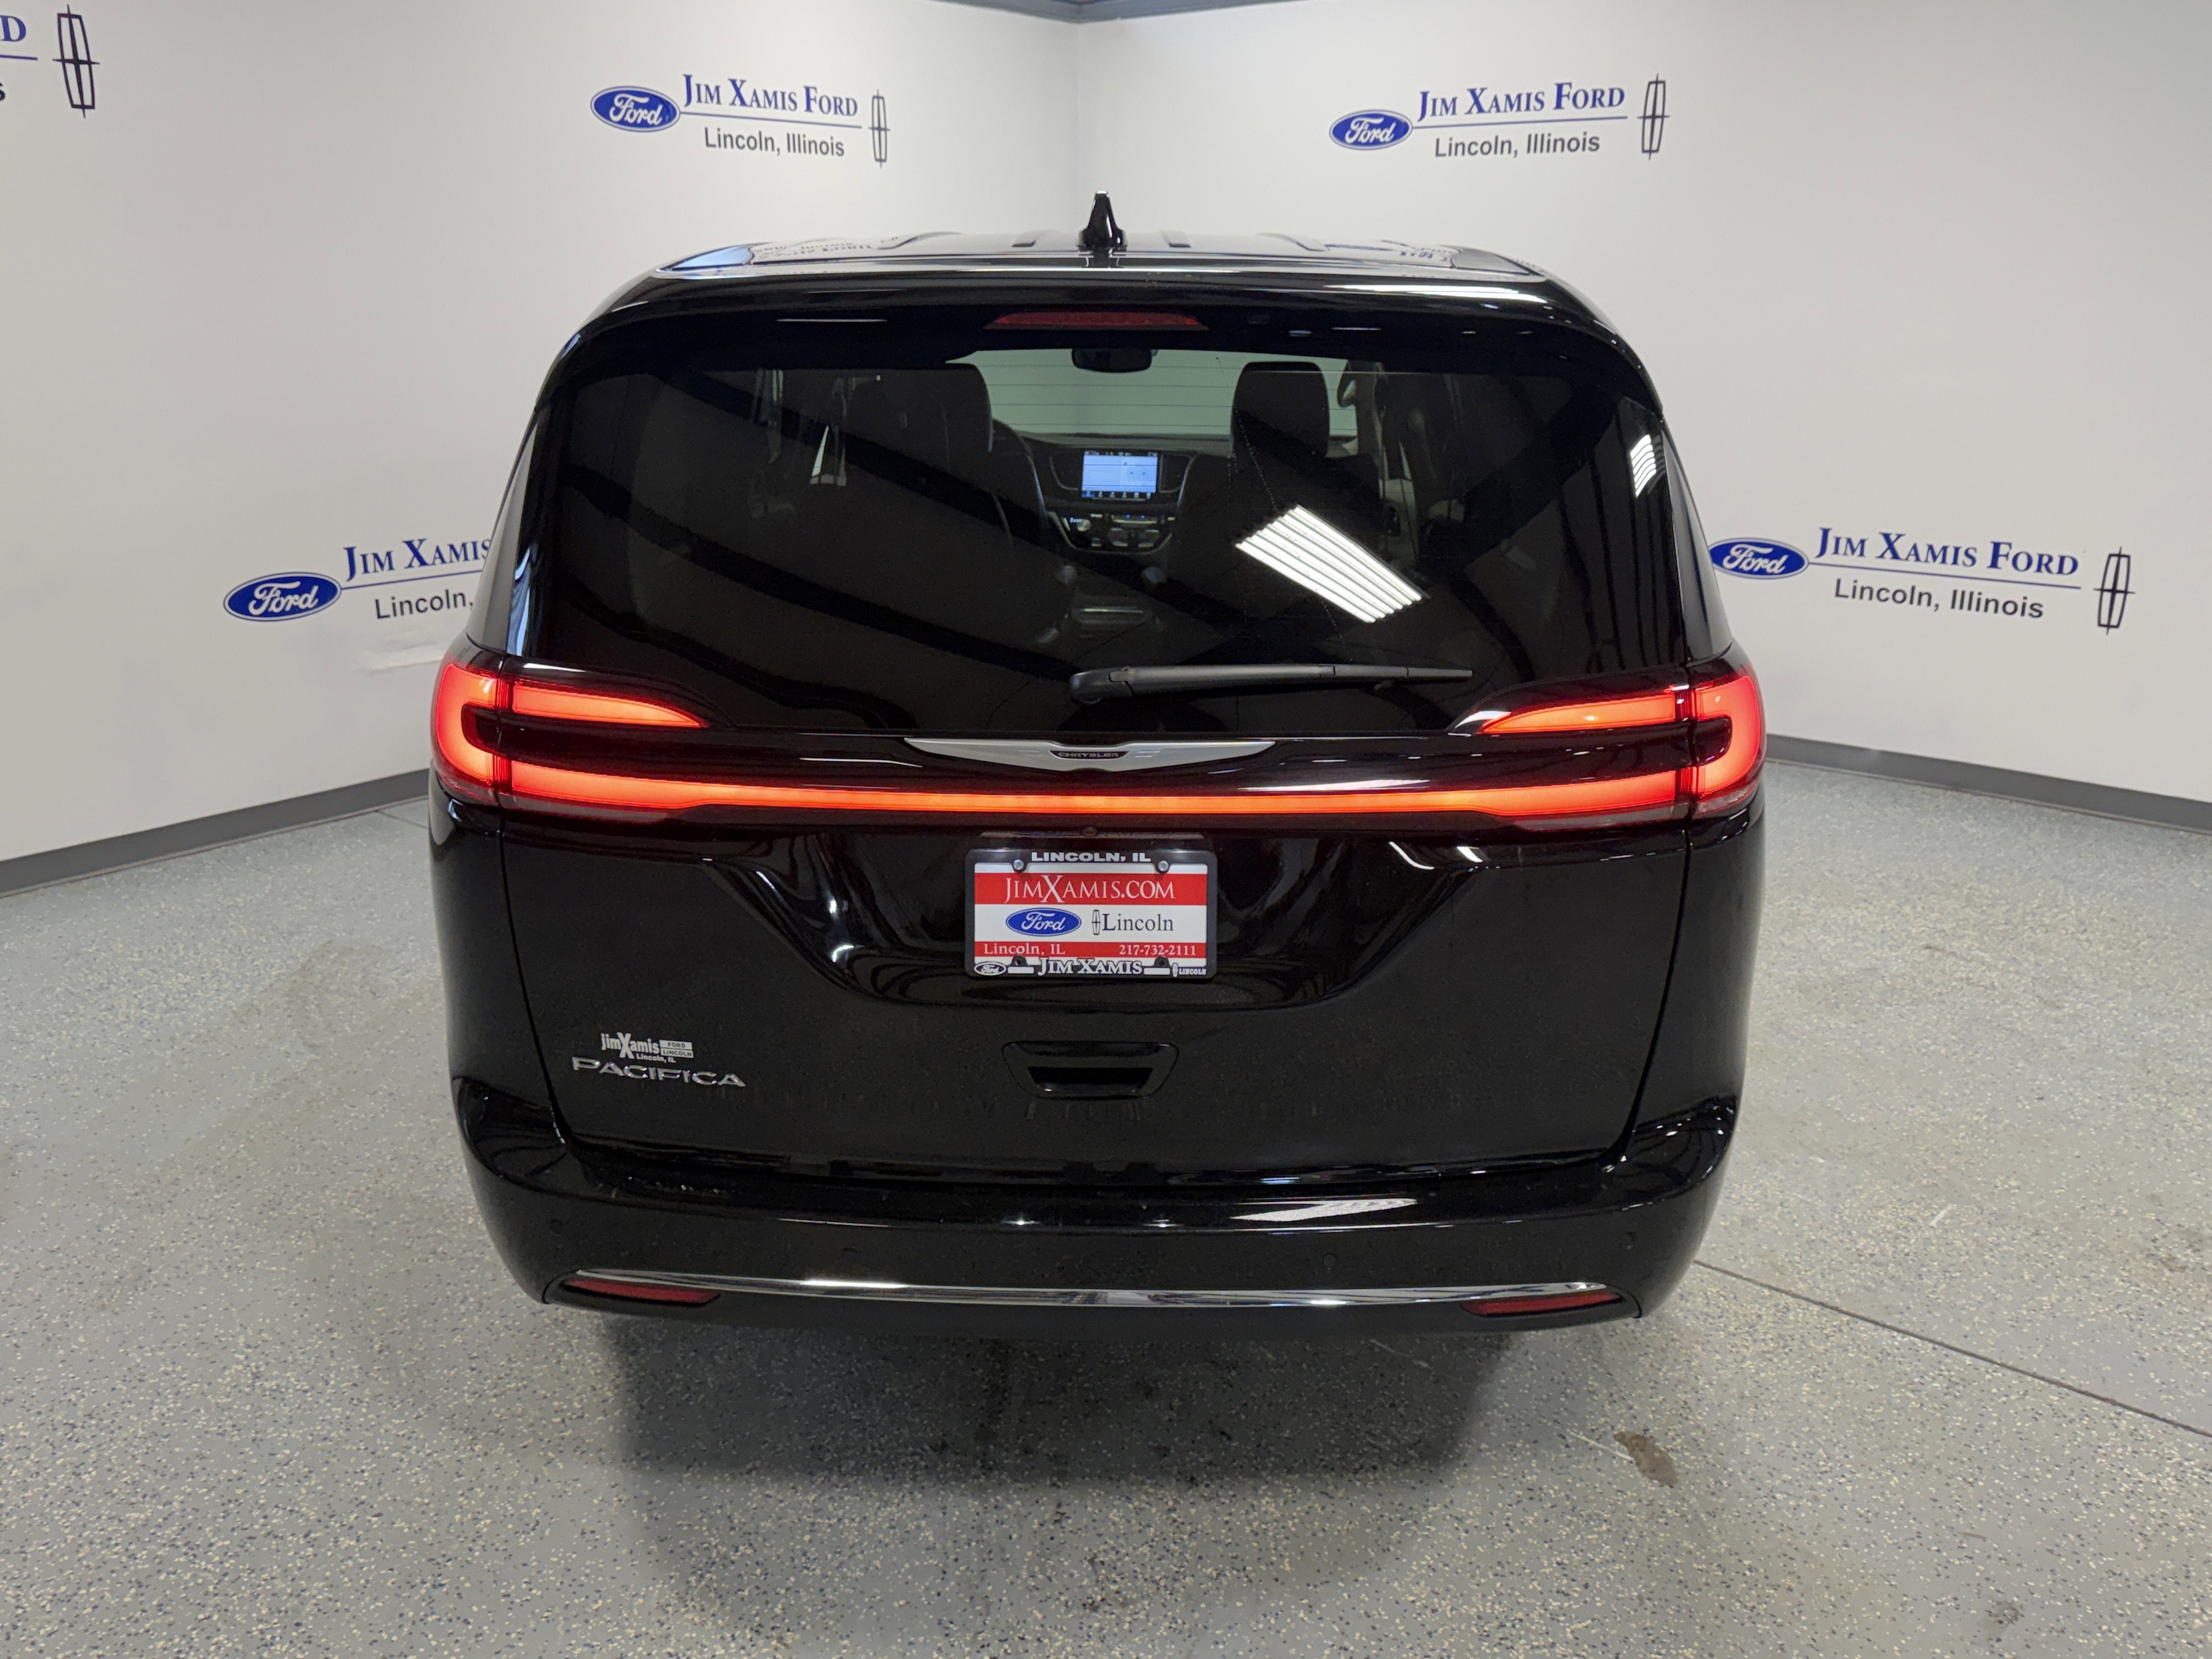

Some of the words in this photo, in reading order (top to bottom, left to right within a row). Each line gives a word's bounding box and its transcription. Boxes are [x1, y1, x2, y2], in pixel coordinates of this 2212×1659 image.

[682, 74, 721, 108] JIM
[727, 78, 798, 111] XAMIS
[803, 85, 859, 116] FORD
[1417, 91, 1458, 122] JIM
[1465, 87, 1545, 115] XAMIS
[1554, 82, 1626, 110] FORD
[609, 93, 663, 126] Ford
[704, 127, 781, 155] Lincoln,
[787, 133, 845, 157] Illinois
[1344, 117, 1395, 144] Ford
[1434, 136, 1519, 158] Lincoln,
[1527, 132, 1601, 155] Illinois
[343, 546, 395, 582] JIM
[1722, 546, 1788, 574] Ford
[1815, 527, 1869, 558] JIM
[1876, 531, 1978, 567] XAMIS
[1986, 540, 2079, 576] FORD
[249, 581, 319, 616] Ford
[1834, 578, 1940, 612] Lincoln,
[1949, 589, 2044, 619] Illinois
[1031, 851, 1127, 862] LINCOLN,
[1132, 853, 1152, 862] IL
[1004, 875, 1175, 904] JIMXAMIS.COM
[1021, 912, 1065, 931] Ford
[1102, 913, 1173, 931] Lincoln
[984, 943, 1045, 957] Lincoln,
[1050, 944, 1065, 955] IL
[1118, 944, 1196, 956] 217-732-2111
[981, 964, 1000, 973] Ford
[1037, 957, 1074, 976] JIM
[1077, 958, 1143, 975] XAMIS
[572, 1057, 746, 1087] PACIFICA
[635, 1053, 667, 1063] Lincoln,
